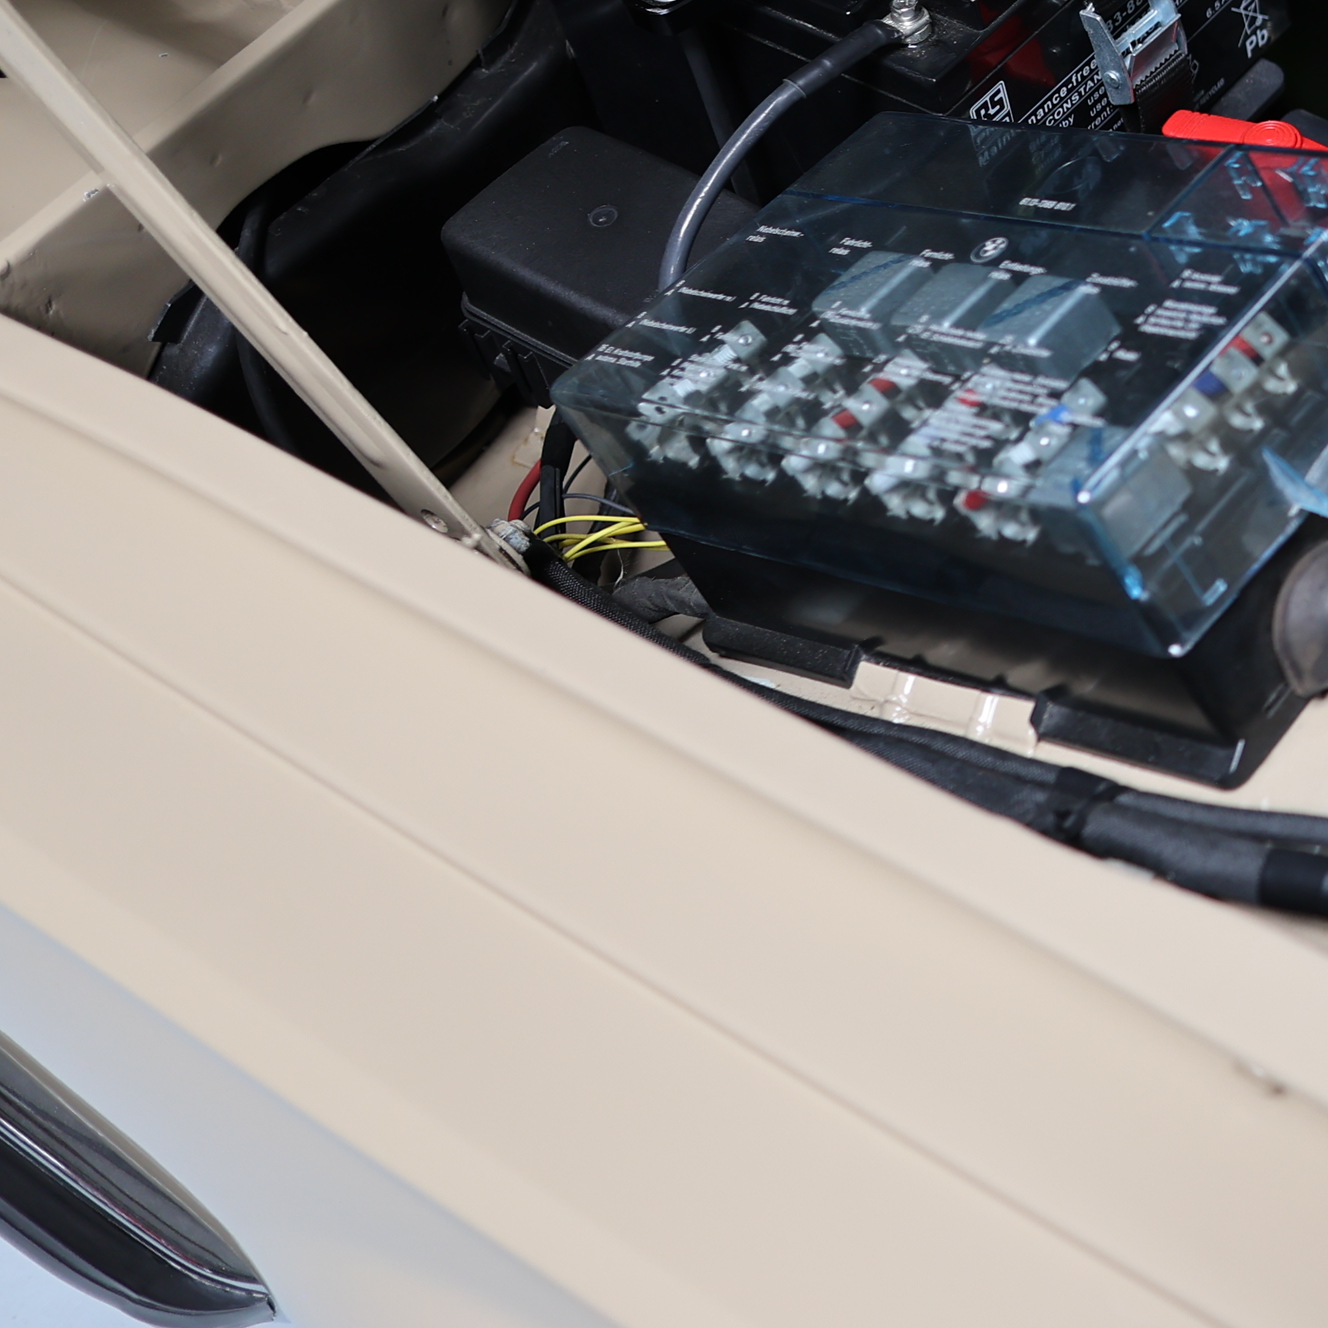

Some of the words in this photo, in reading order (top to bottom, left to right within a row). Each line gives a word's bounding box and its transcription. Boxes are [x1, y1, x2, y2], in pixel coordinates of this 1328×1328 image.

[1245, 28, 1269, 59] Pb
[1027, 59, 1098, 125] nance-free
[1045, 72, 1101, 127] CONSTAN
